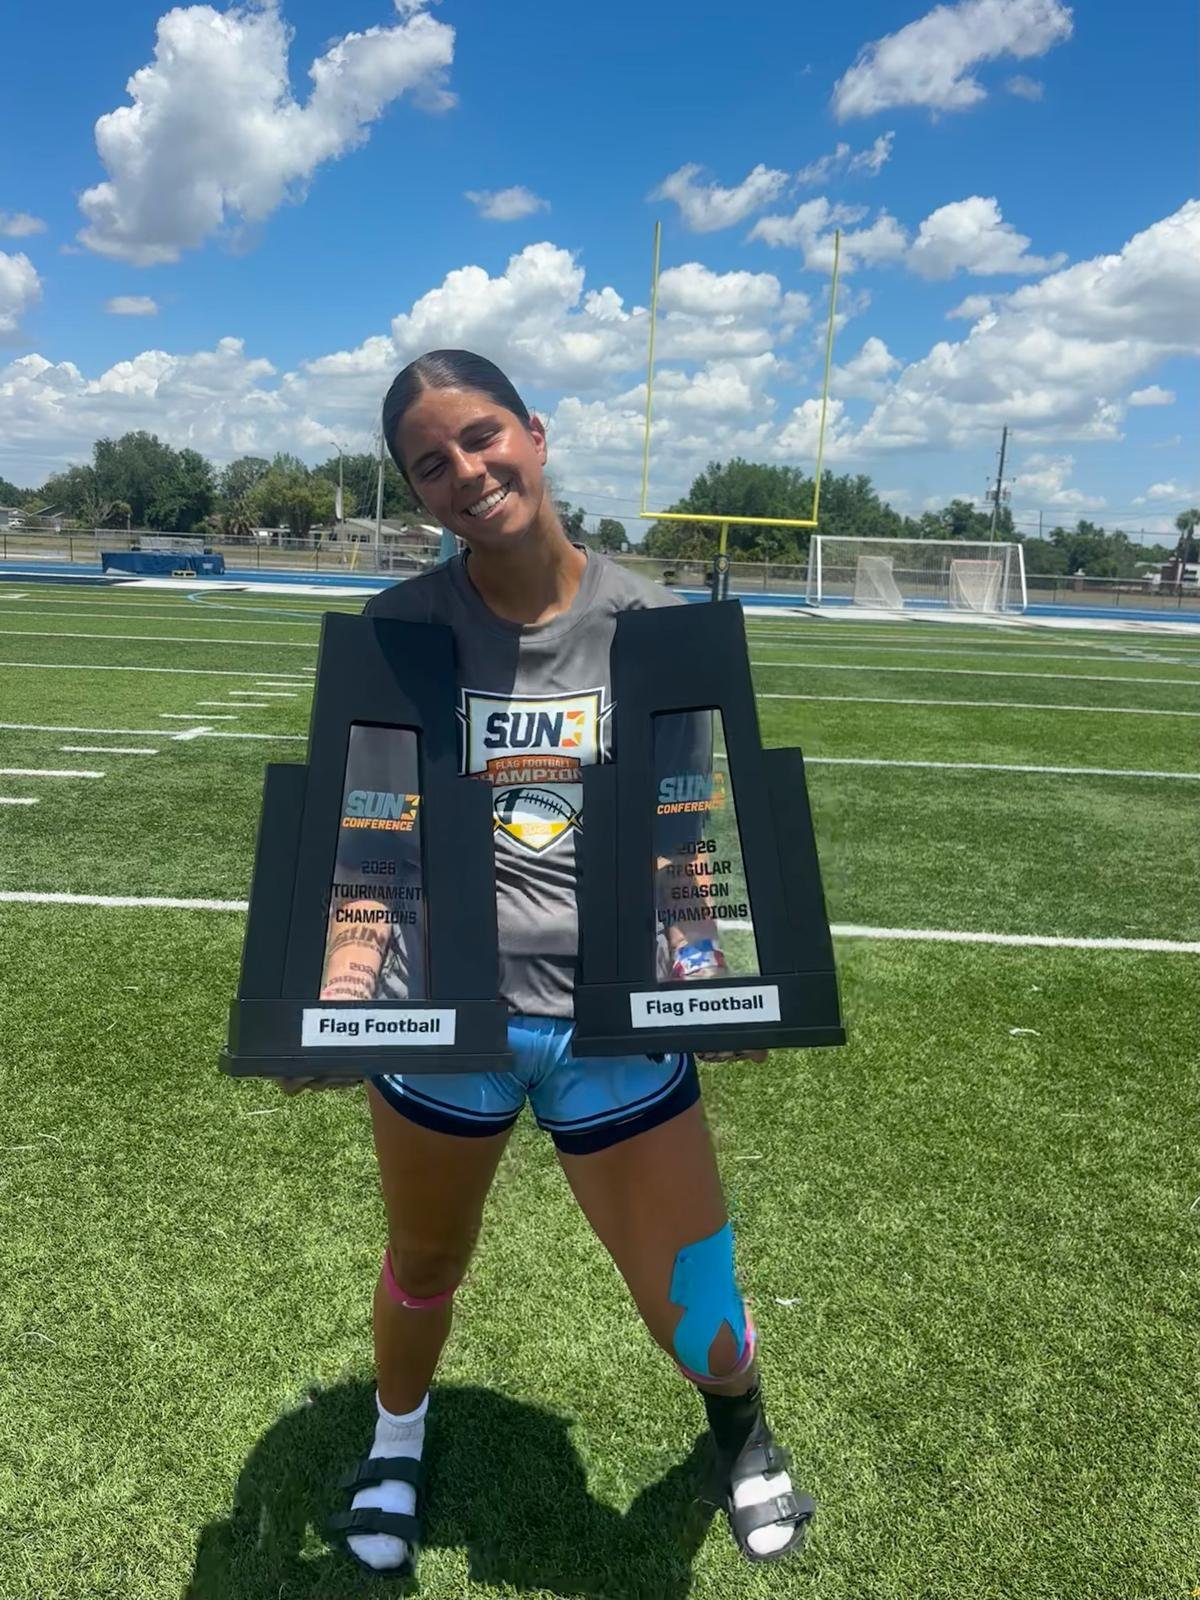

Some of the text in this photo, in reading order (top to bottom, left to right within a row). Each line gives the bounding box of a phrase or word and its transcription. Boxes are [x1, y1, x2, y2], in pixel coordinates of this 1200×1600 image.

[484, 710, 564, 748] SUN
[496, 759, 521, 771] FLAG
[345, 789, 406, 819] SUN
[341, 816, 414, 832] CONFERENCE
[361, 860, 396, 875] 2026
[332, 883, 422, 901] TOURNAMENT
[671, 882, 729, 900] SEASON
[335, 908, 417, 925] CHAMPIONS
[656, 904, 748, 923] CHAMPIONS
[646, 995, 764, 1019] Flag Football
[319, 1017, 440, 1036] Flag Football
